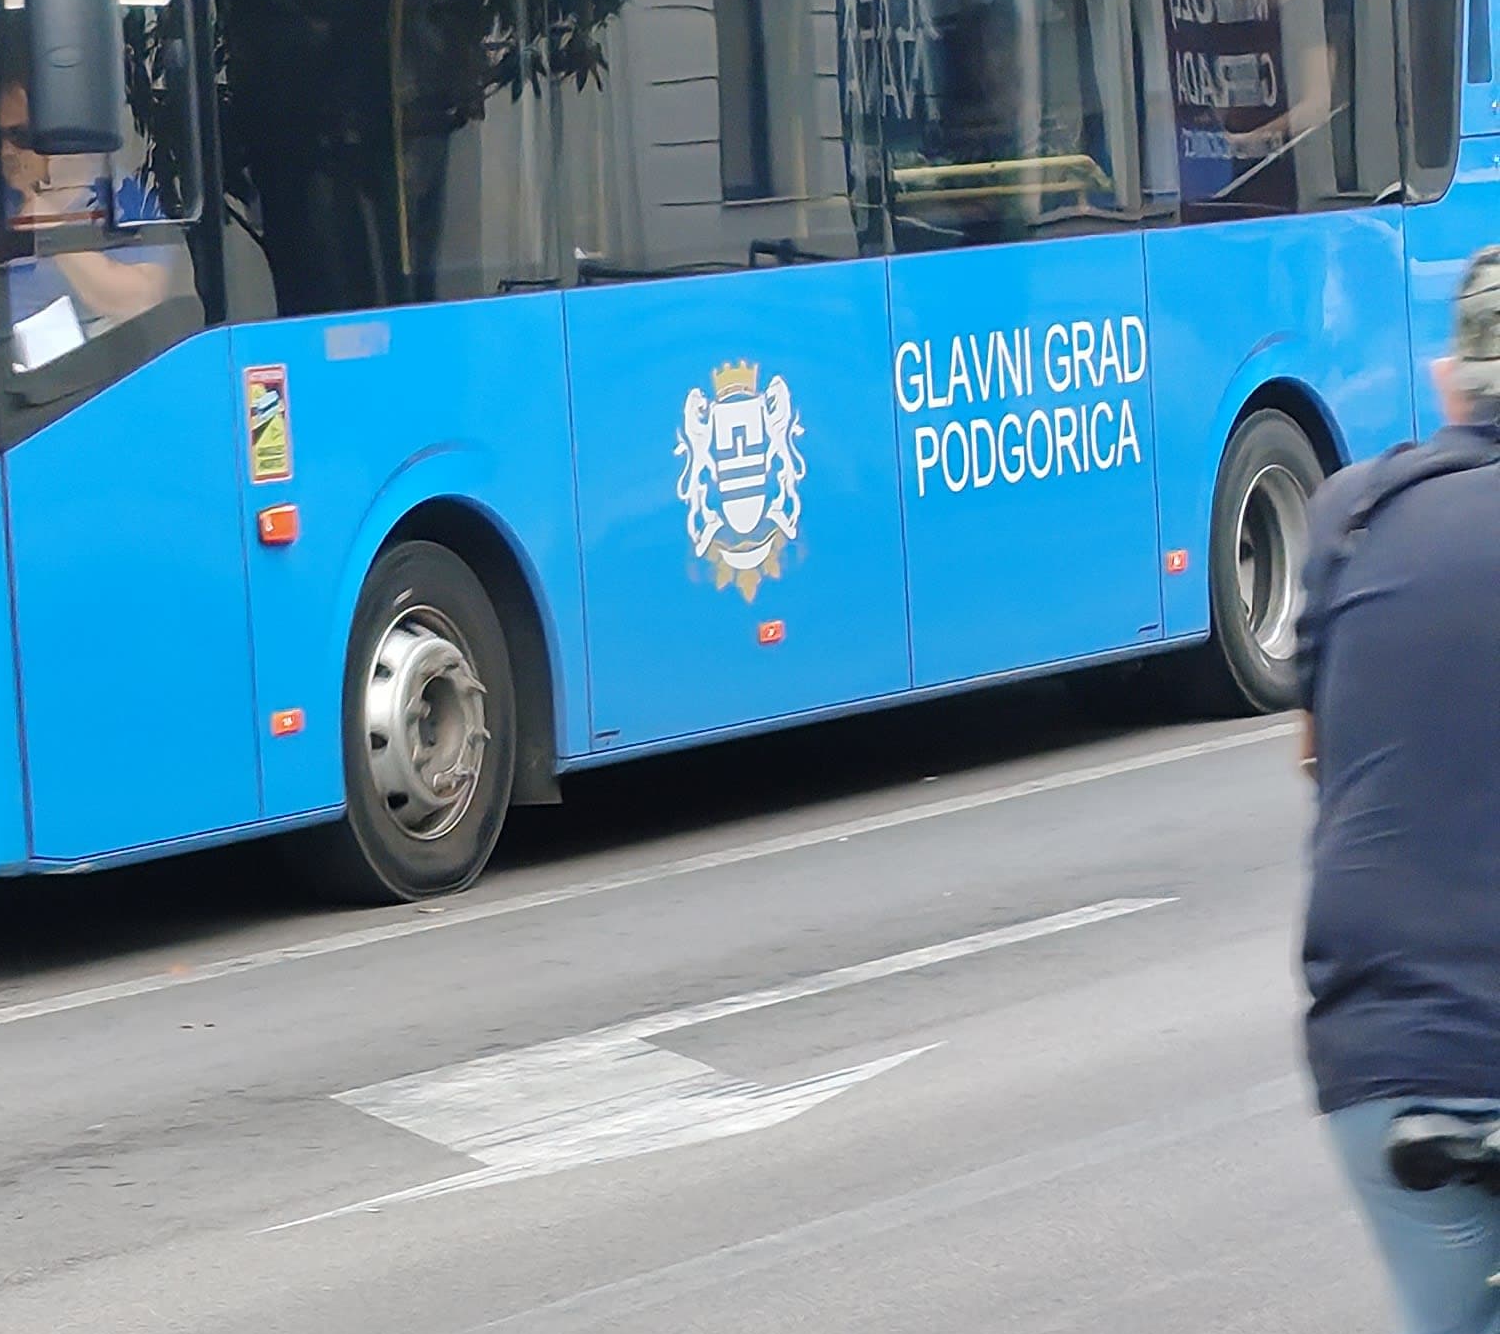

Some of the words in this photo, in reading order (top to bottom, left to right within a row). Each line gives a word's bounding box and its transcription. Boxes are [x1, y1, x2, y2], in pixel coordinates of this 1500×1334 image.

[895, 327, 1033, 412] GLAVNI
[1044, 315, 1147, 392] GRAD
[915, 399, 1141, 497] PODGORICA
